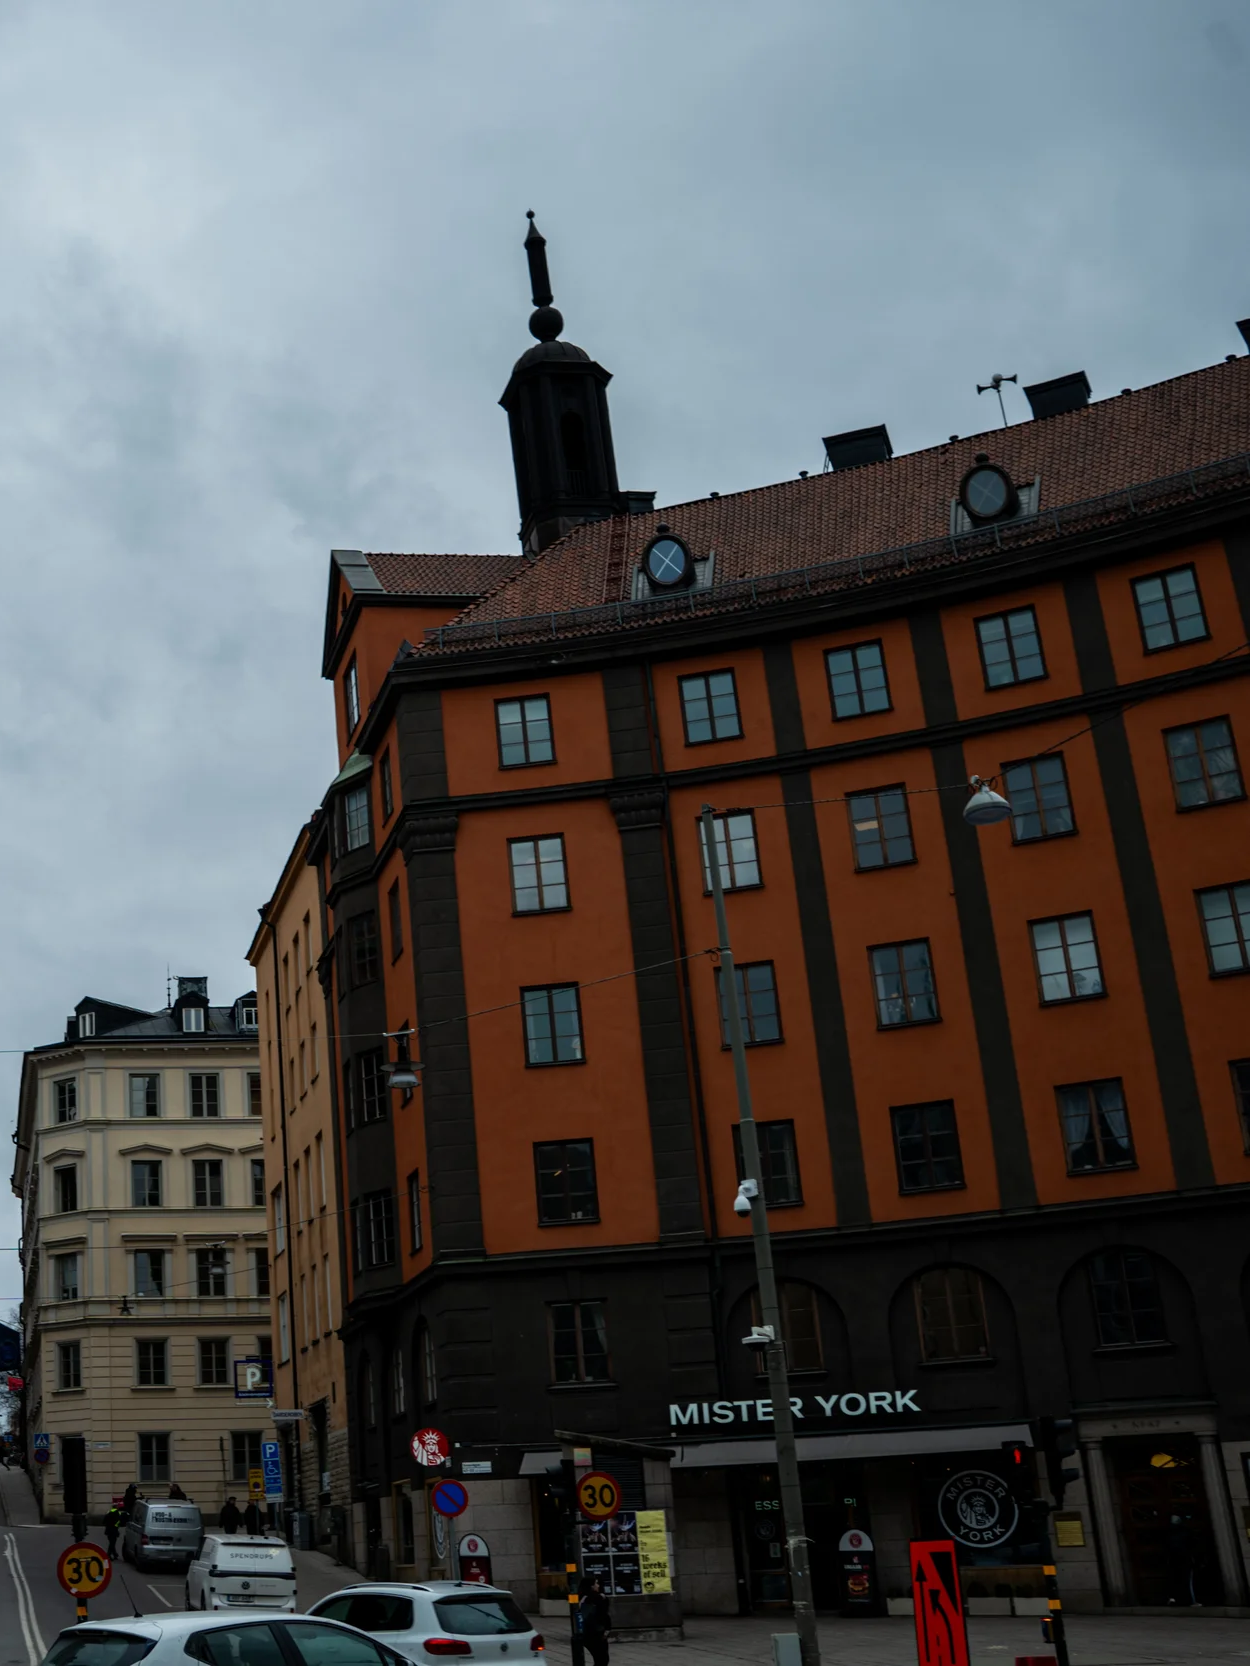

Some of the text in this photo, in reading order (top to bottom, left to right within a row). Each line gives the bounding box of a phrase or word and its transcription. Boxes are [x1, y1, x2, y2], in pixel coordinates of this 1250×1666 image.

[246, 1367, 261, 1391] P
[668, 1388, 923, 1426] MISTER YORK
[265, 1444, 276, 1458] P
[582, 1484, 615, 1508] 30
[945, 1475, 1007, 1501] MISTER
[958, 1523, 1007, 1542] YORK
[229, 1552, 274, 1560] SPENDRUPS
[66, 1556, 104, 1585] 30
